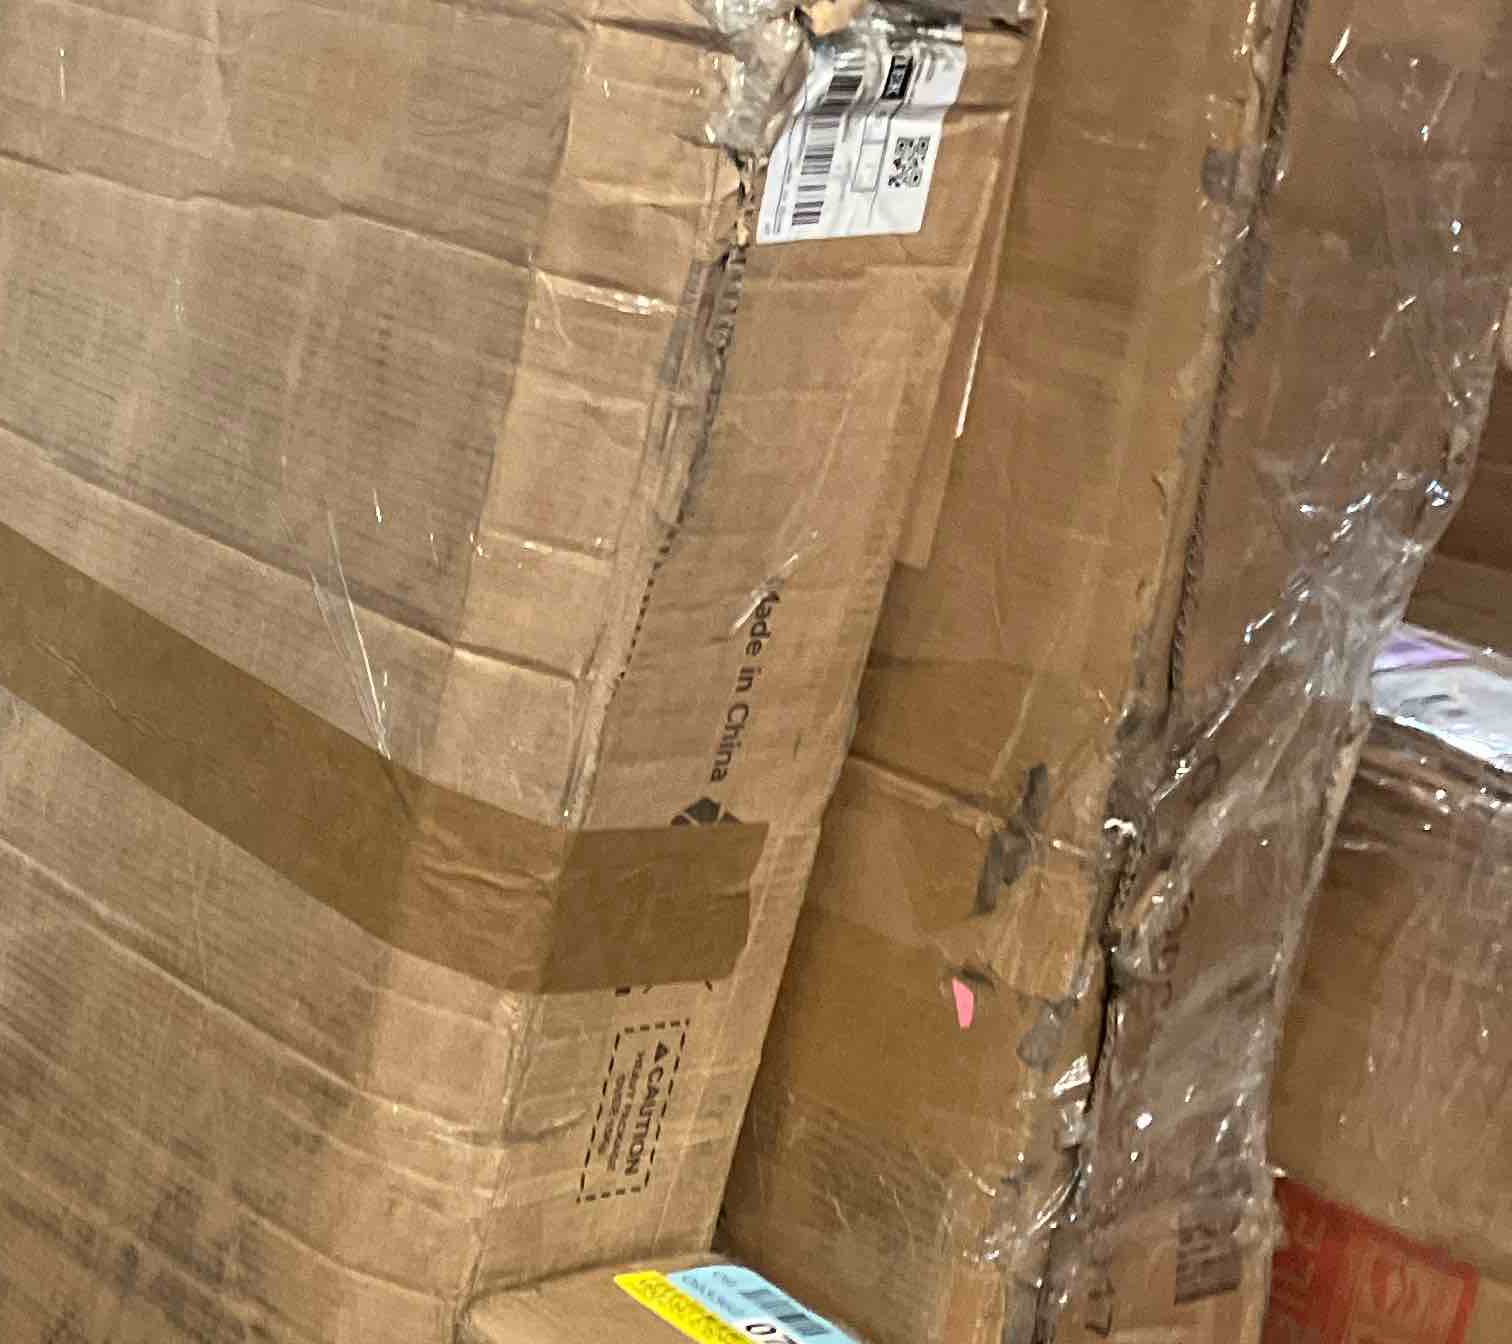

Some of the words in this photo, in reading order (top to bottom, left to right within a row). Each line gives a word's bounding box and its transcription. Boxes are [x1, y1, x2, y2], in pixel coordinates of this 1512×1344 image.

[735, 665, 763, 694] in
[709, 703, 750, 783] China
[624, 1065, 664, 1176] CAUTION
